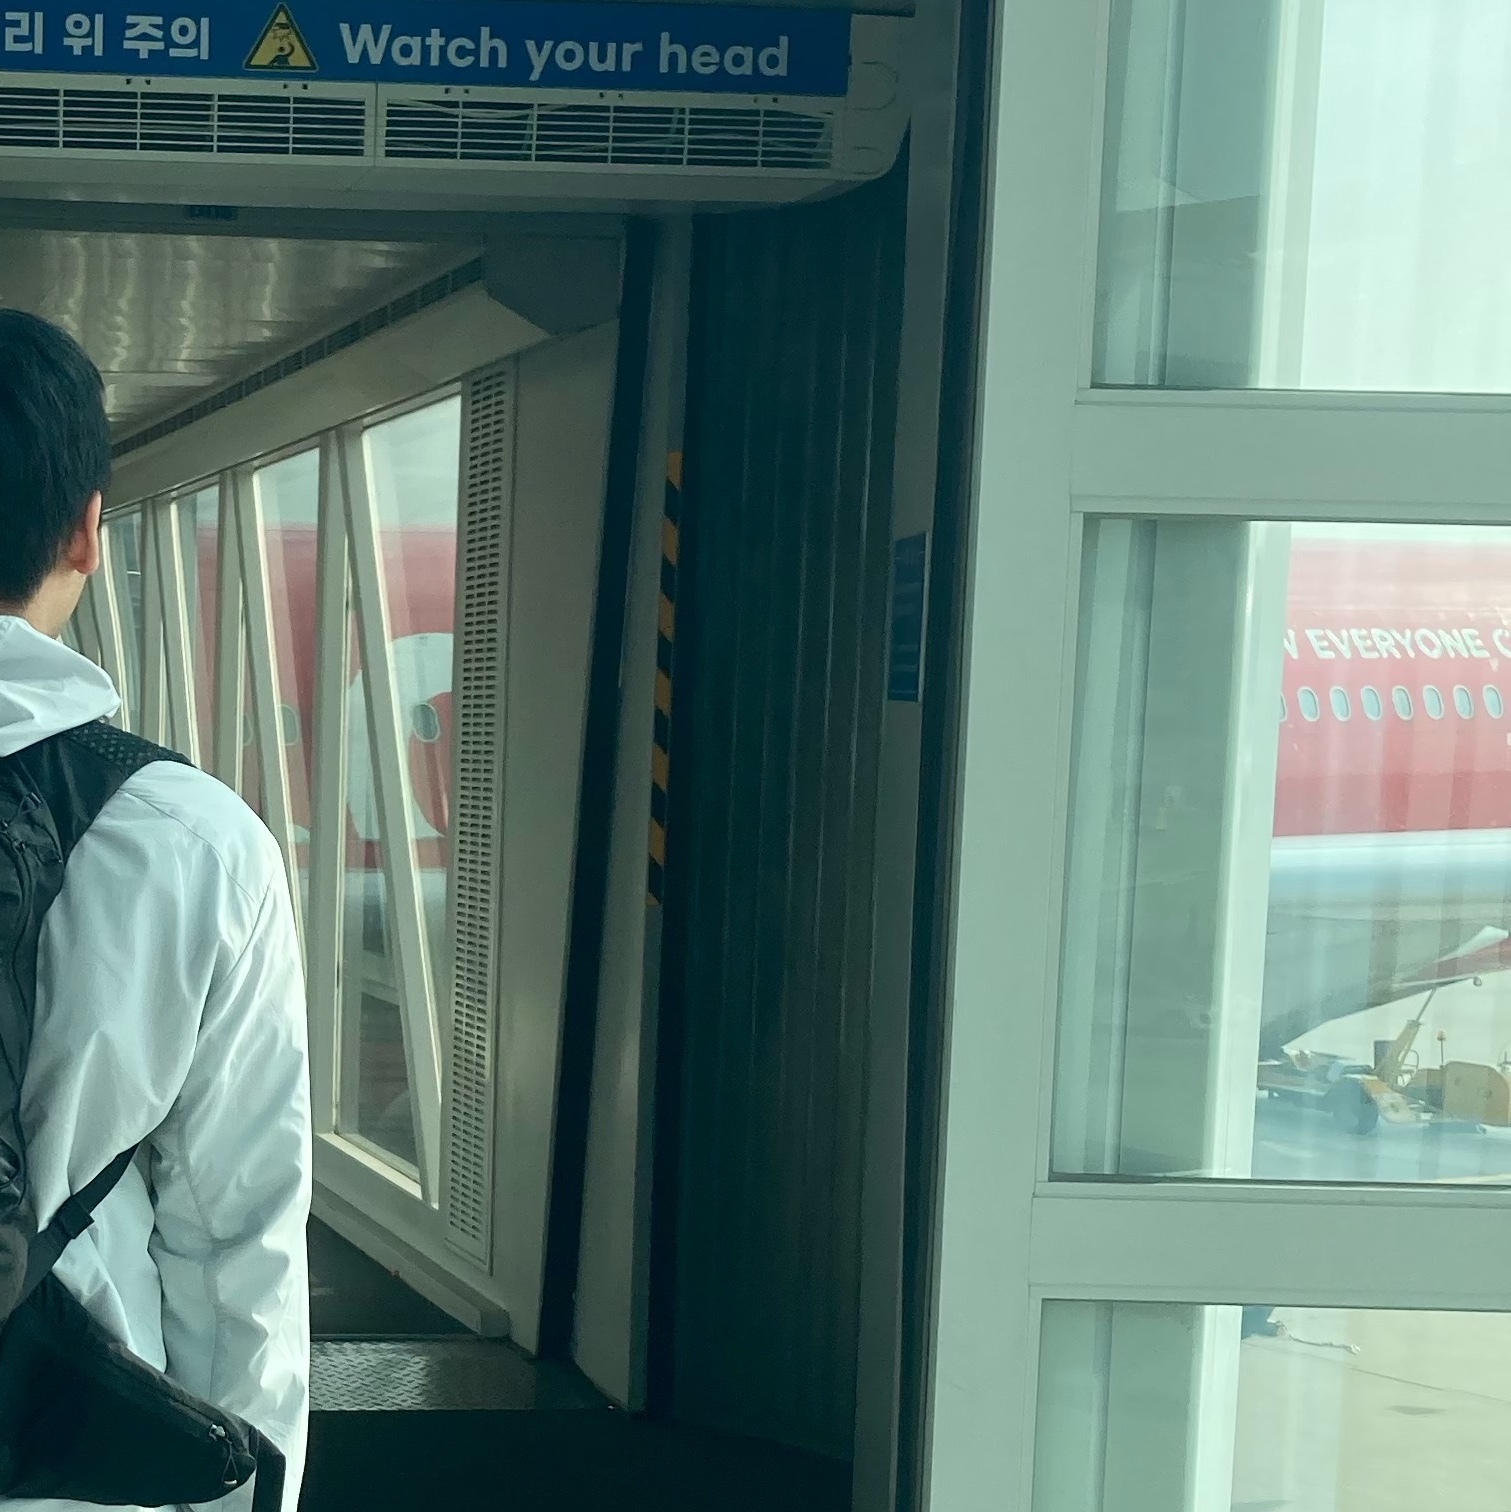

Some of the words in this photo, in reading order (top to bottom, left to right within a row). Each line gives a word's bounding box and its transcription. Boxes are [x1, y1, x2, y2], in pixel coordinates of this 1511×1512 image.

[63, 13, 104, 57] 위
[123, 15, 210, 60] 주의
[339, 23, 508, 69] Watch
[525, 40, 644, 82] your
[659, 32, 789, 77] head
[1304, 628, 1491, 660] EVERYONE
